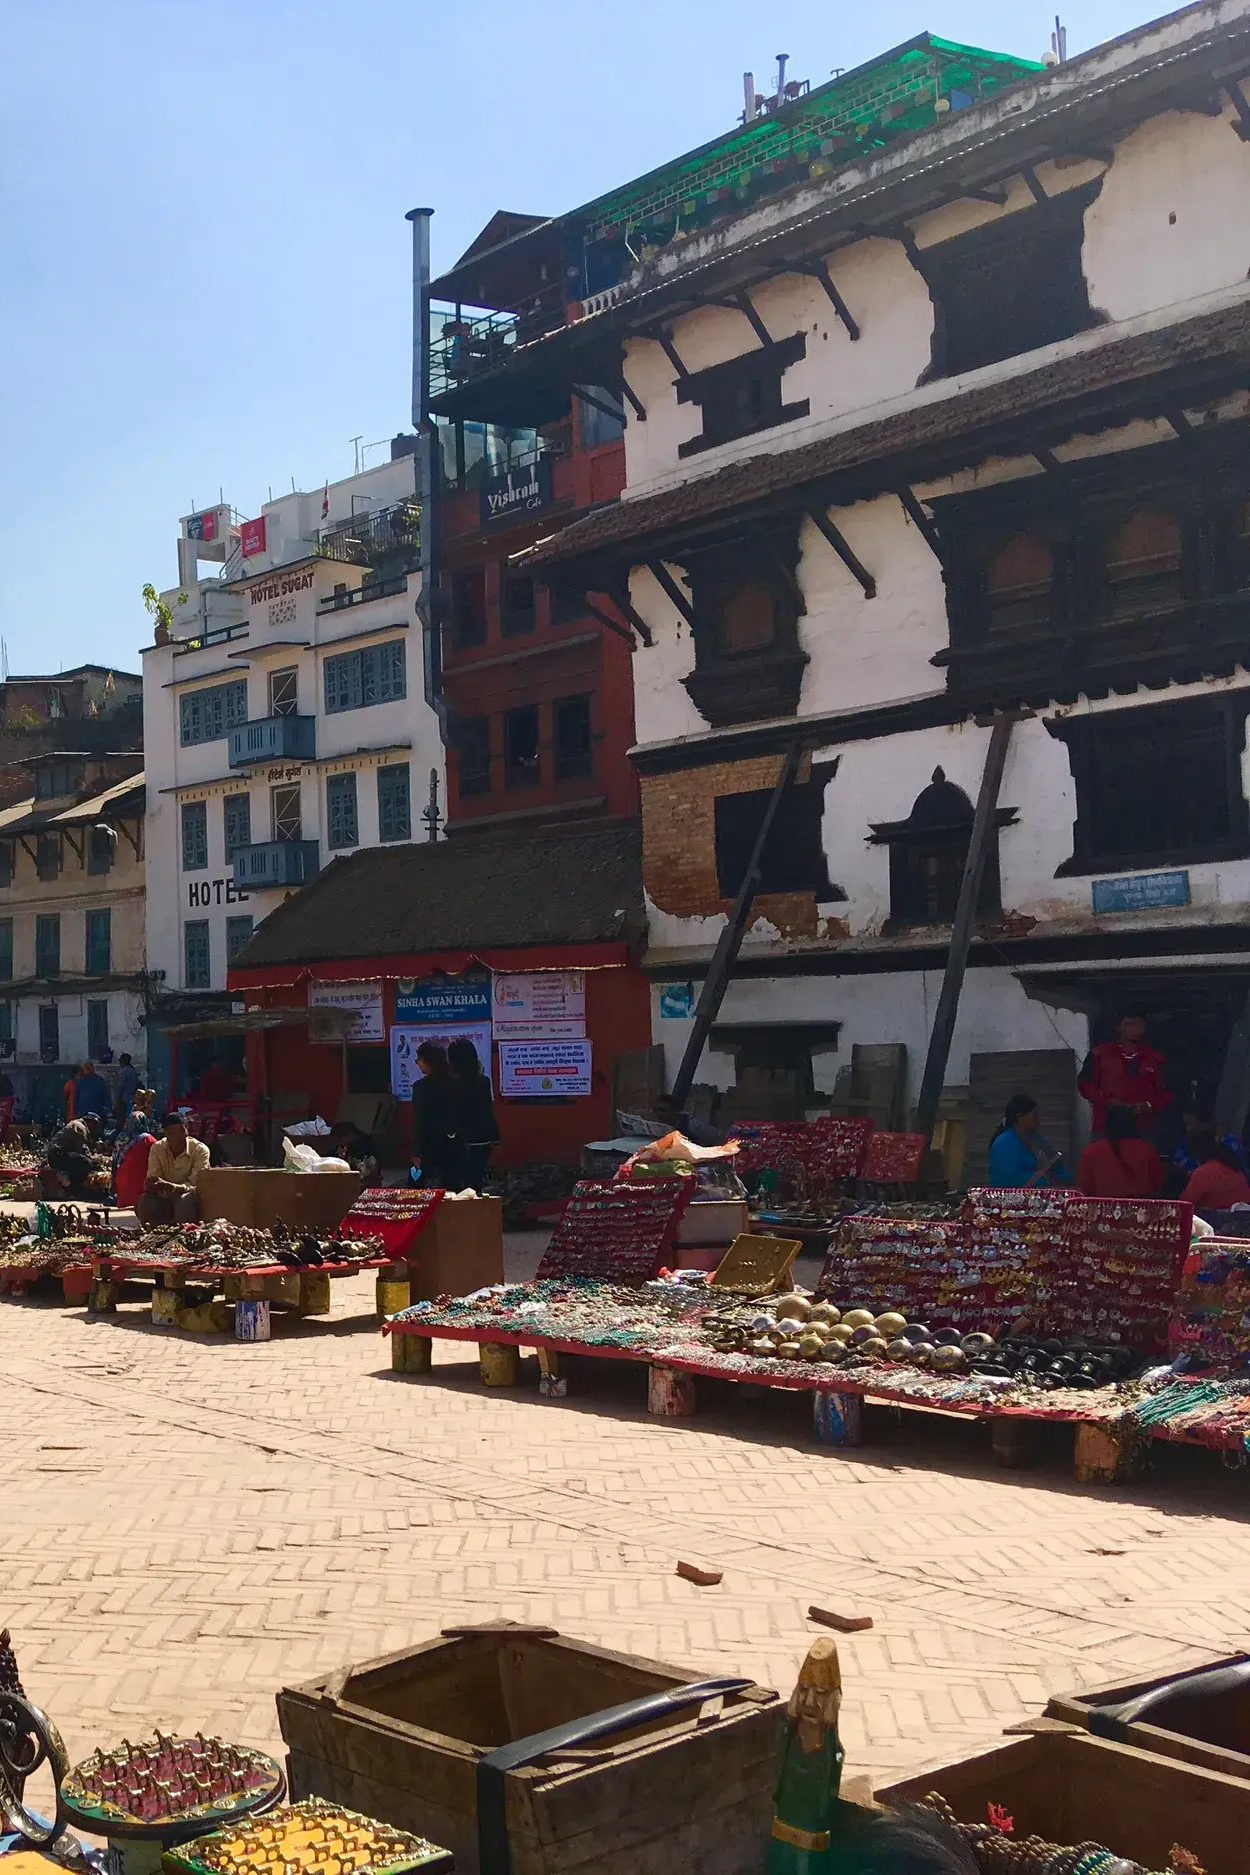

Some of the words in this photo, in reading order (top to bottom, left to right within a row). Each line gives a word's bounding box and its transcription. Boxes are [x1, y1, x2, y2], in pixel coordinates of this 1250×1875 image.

[250, 583, 280, 606] HOTEL
[281, 571, 315, 596] SUGAT
[397, 997, 425, 1008] SINHA
[426, 996, 453, 1007] SWAN
[454, 994, 488, 1006] KHALA
